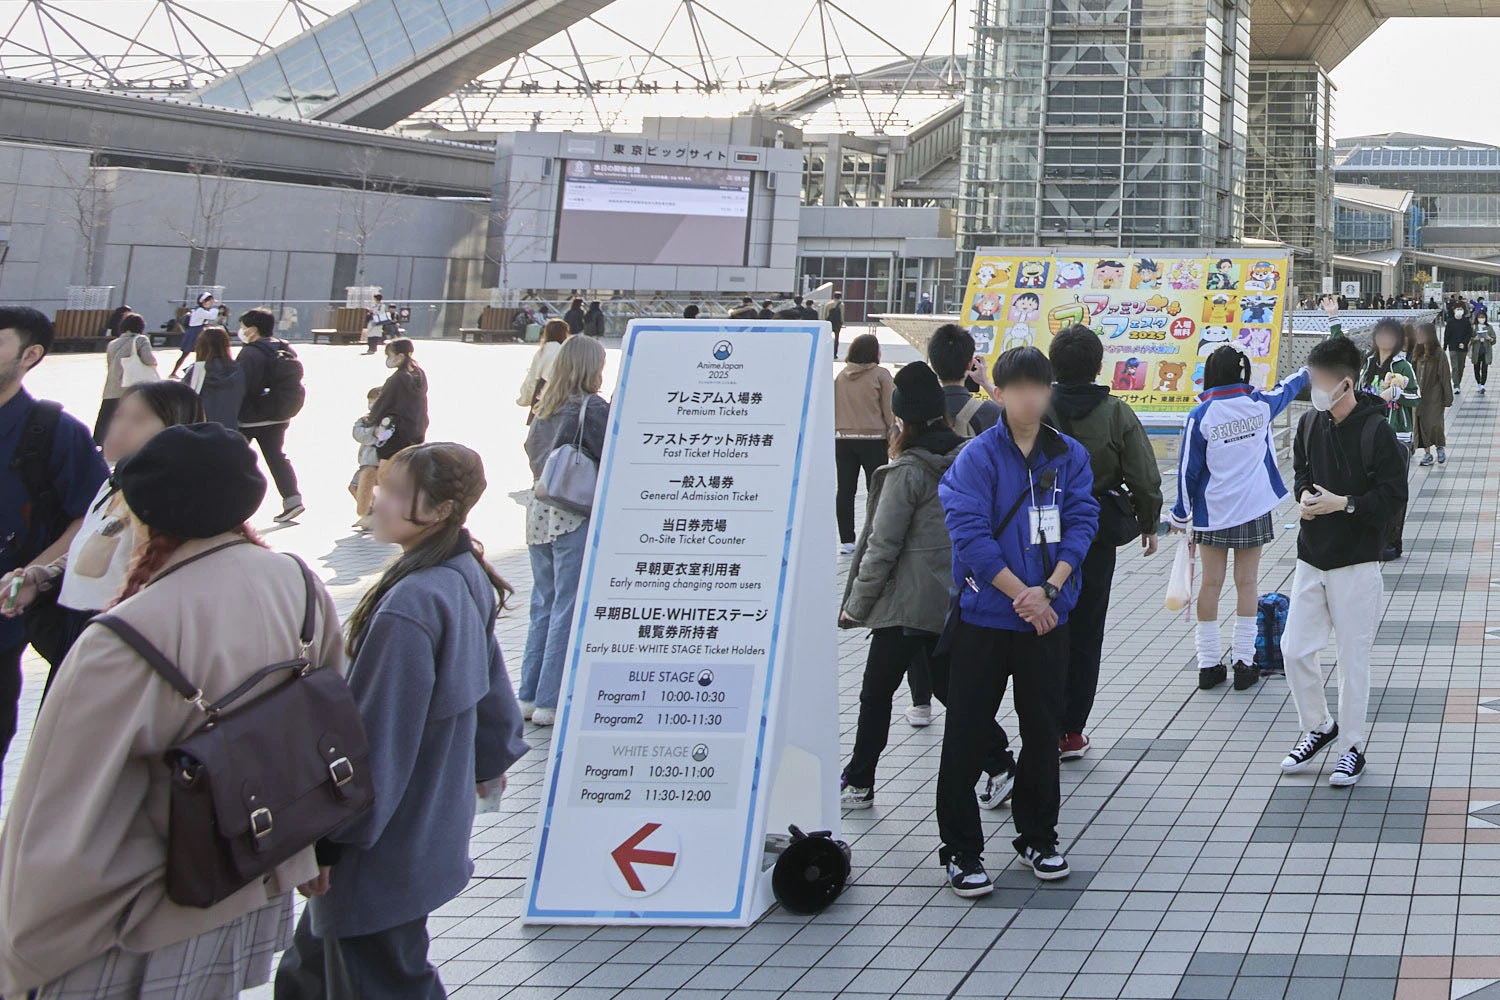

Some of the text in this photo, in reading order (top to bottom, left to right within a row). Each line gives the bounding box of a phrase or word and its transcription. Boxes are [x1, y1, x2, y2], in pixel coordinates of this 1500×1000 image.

[613, 144, 726, 161] 東京ビッグサイト
[1083, 295, 1160, 315] ファミリー
[1101, 316, 1168, 338] フェスタ
[1129, 331, 1166, 340] 2025
[696, 362, 744, 370] AnimeJapan
[708, 370, 730, 379] 2025
[667, 391, 763, 405] プレミアム入場券
[677, 407, 748, 416] Premium Tickets
[1210, 414, 1263, 441] SEIGAKU
[643, 432, 774, 447] ファストチケット所持者
[663, 448, 749, 458] Fast Ticket Holders
[669, 475, 734, 489] 一般入場券
[640, 490, 759, 502] General Admission Ticket
[662, 518, 727, 532] 当日券売場
[640, 534, 746, 545] On-Site Ticket Counter
[635, 562, 741, 576] 早朝更衣室利用者
[610, 578, 632, 590] Early
[634, 578, 670, 591] morning
[672, 579, 713, 592] changing
[715, 581, 738, 589] room
[638, 625, 719, 640] 観覧券所持者
[586, 644, 609, 656] Early
[671, 644, 702, 654] STAGE
[705, 645, 729, 654] Ticket
[732, 646, 765, 655] Holders
[628, 672, 695, 682] BLUE STAGE
[598, 690, 725, 704] Program1 10:00-10:30
[594, 713, 722, 727] Program2 11:00-11:30
[612, 746, 689, 757] WHITE STAGE
[584, 765, 715, 779] Program1 10:30-11:00
[581, 788, 711, 803] Program2 11:30-12:00
